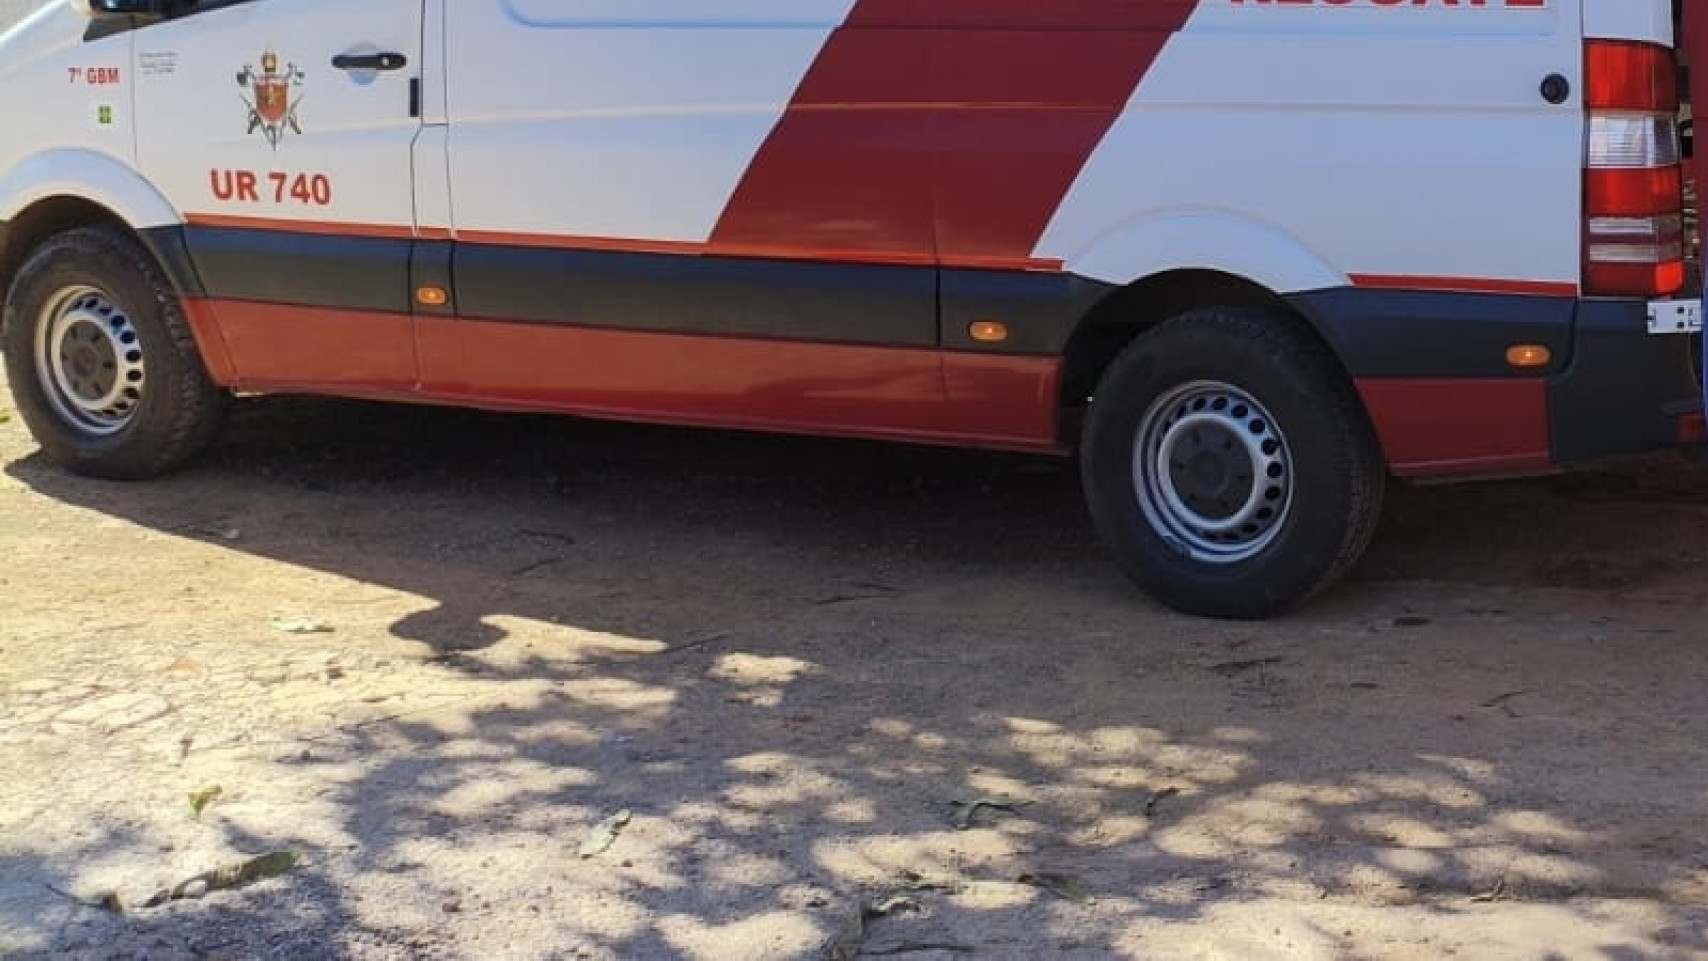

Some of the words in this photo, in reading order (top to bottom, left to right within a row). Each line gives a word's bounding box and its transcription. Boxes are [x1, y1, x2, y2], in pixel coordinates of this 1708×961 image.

[87, 66, 120, 84] GBM
[210, 168, 259, 201] UR
[267, 171, 330, 205] 740
